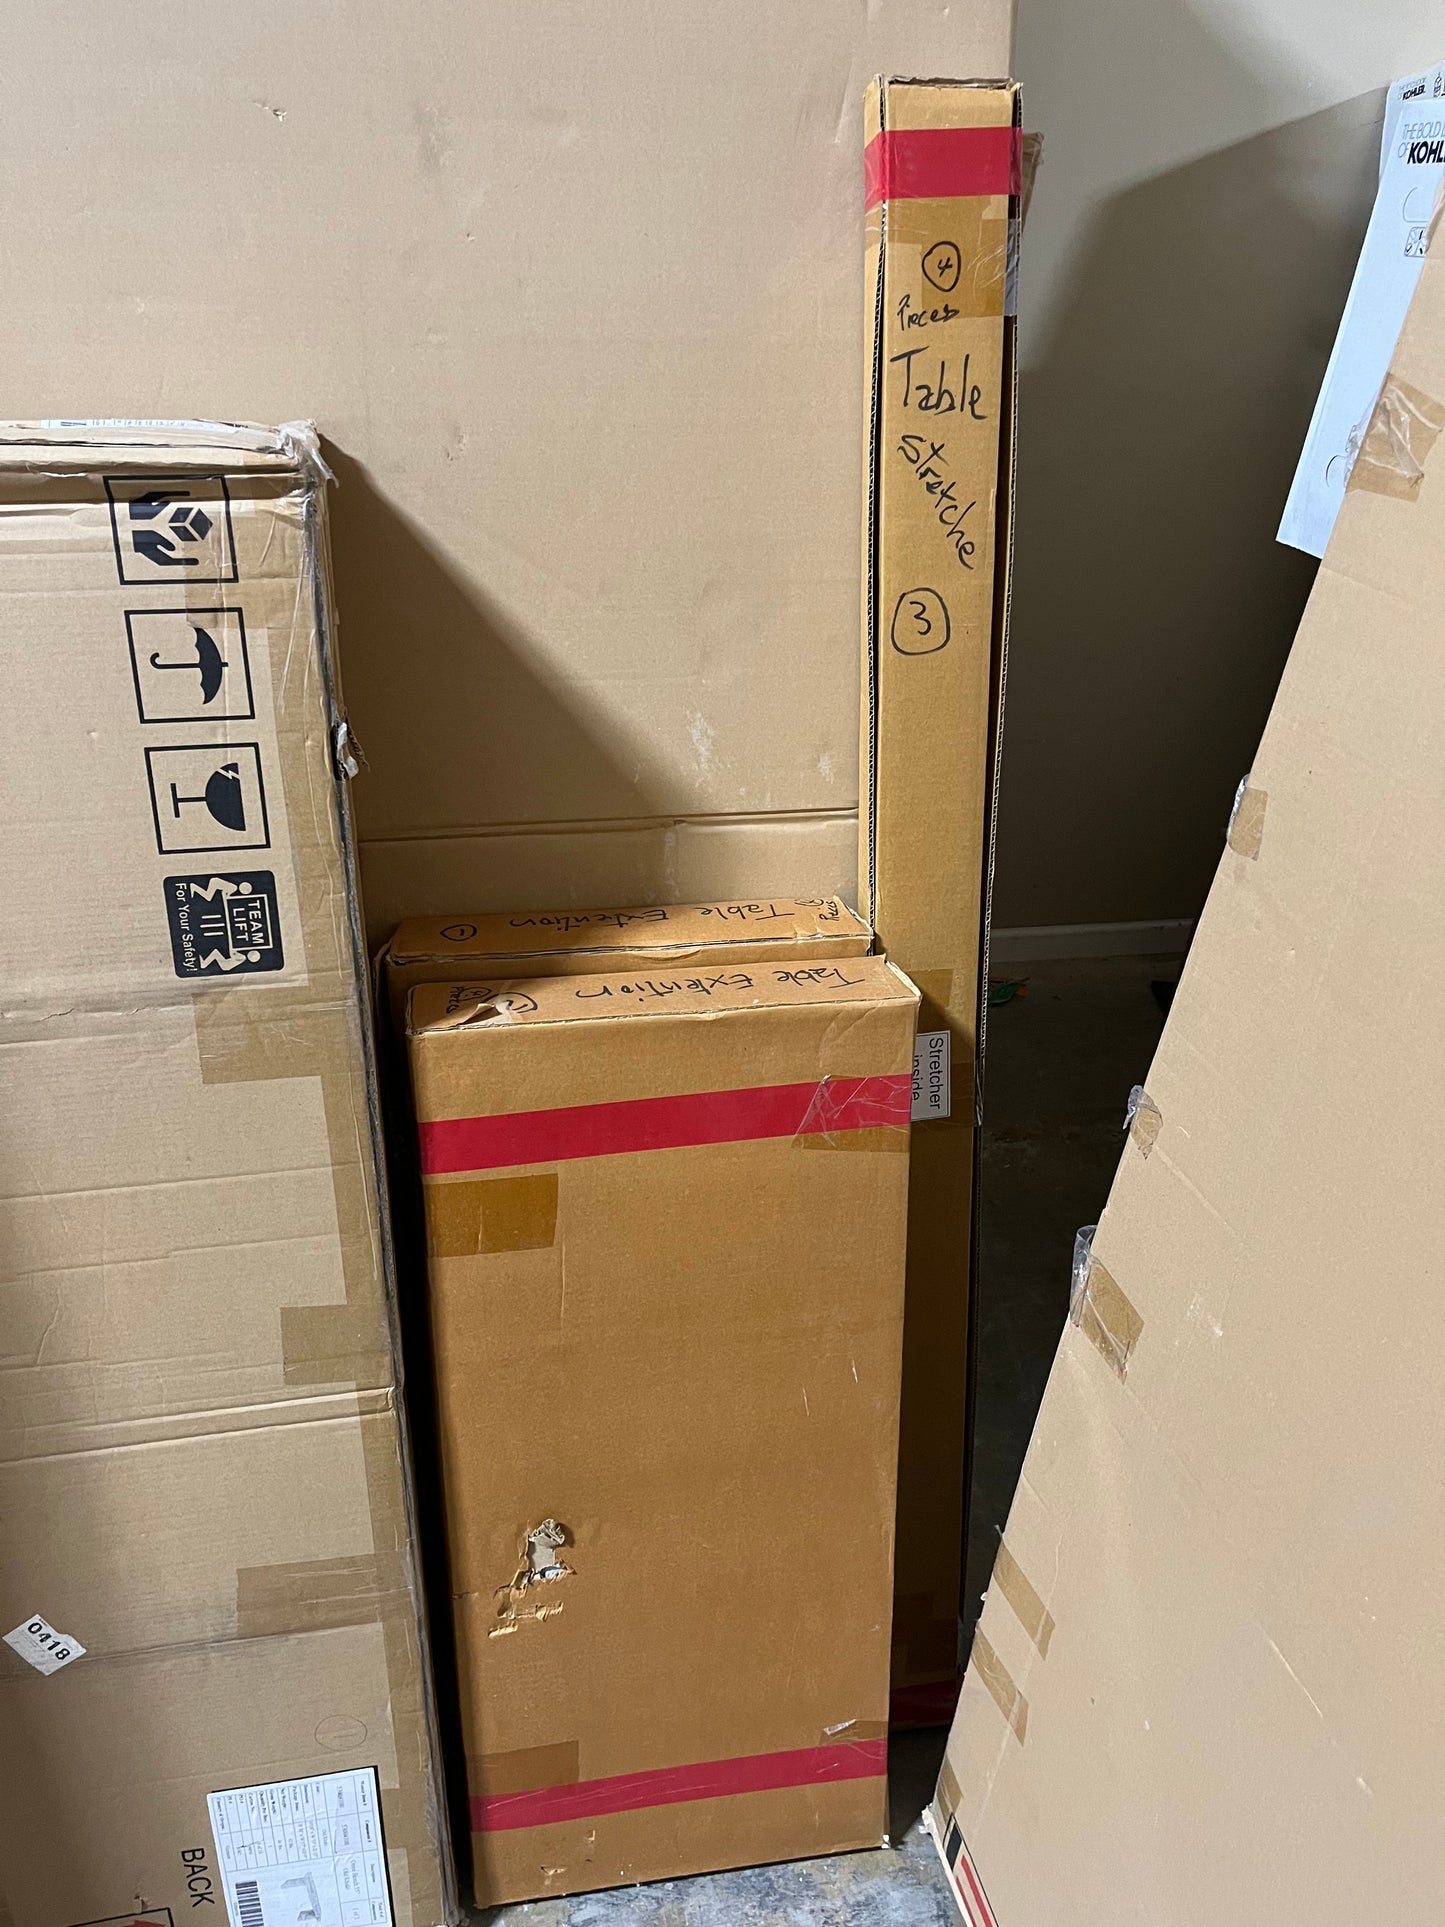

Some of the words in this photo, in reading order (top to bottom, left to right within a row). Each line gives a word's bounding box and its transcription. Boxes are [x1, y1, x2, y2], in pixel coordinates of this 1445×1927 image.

[1402, 123, 1418, 140] THE
[1416, 121, 1442, 139] BOLD
[1398, 142, 1411, 158] OF
[1407, 140, 1445, 165] KOHL
[890, 346, 988, 420] Table
[175, 882, 188, 902] For
[178, 904, 190, 932] Your
[232, 907, 249, 942] LIFT
[247, 899, 265, 945] TEAM
[510, 909, 669, 932] Extention
[694, 904, 795, 921] Table
[182, 933, 198, 972] Safety!
[575, 974, 754, 1003] Extention
[772, 967, 866, 989] Table
[929, 1037, 944, 1110] Stretcher
[27, 1621, 71, 1661] 0418
[181, 1847, 216, 1908] BACK
